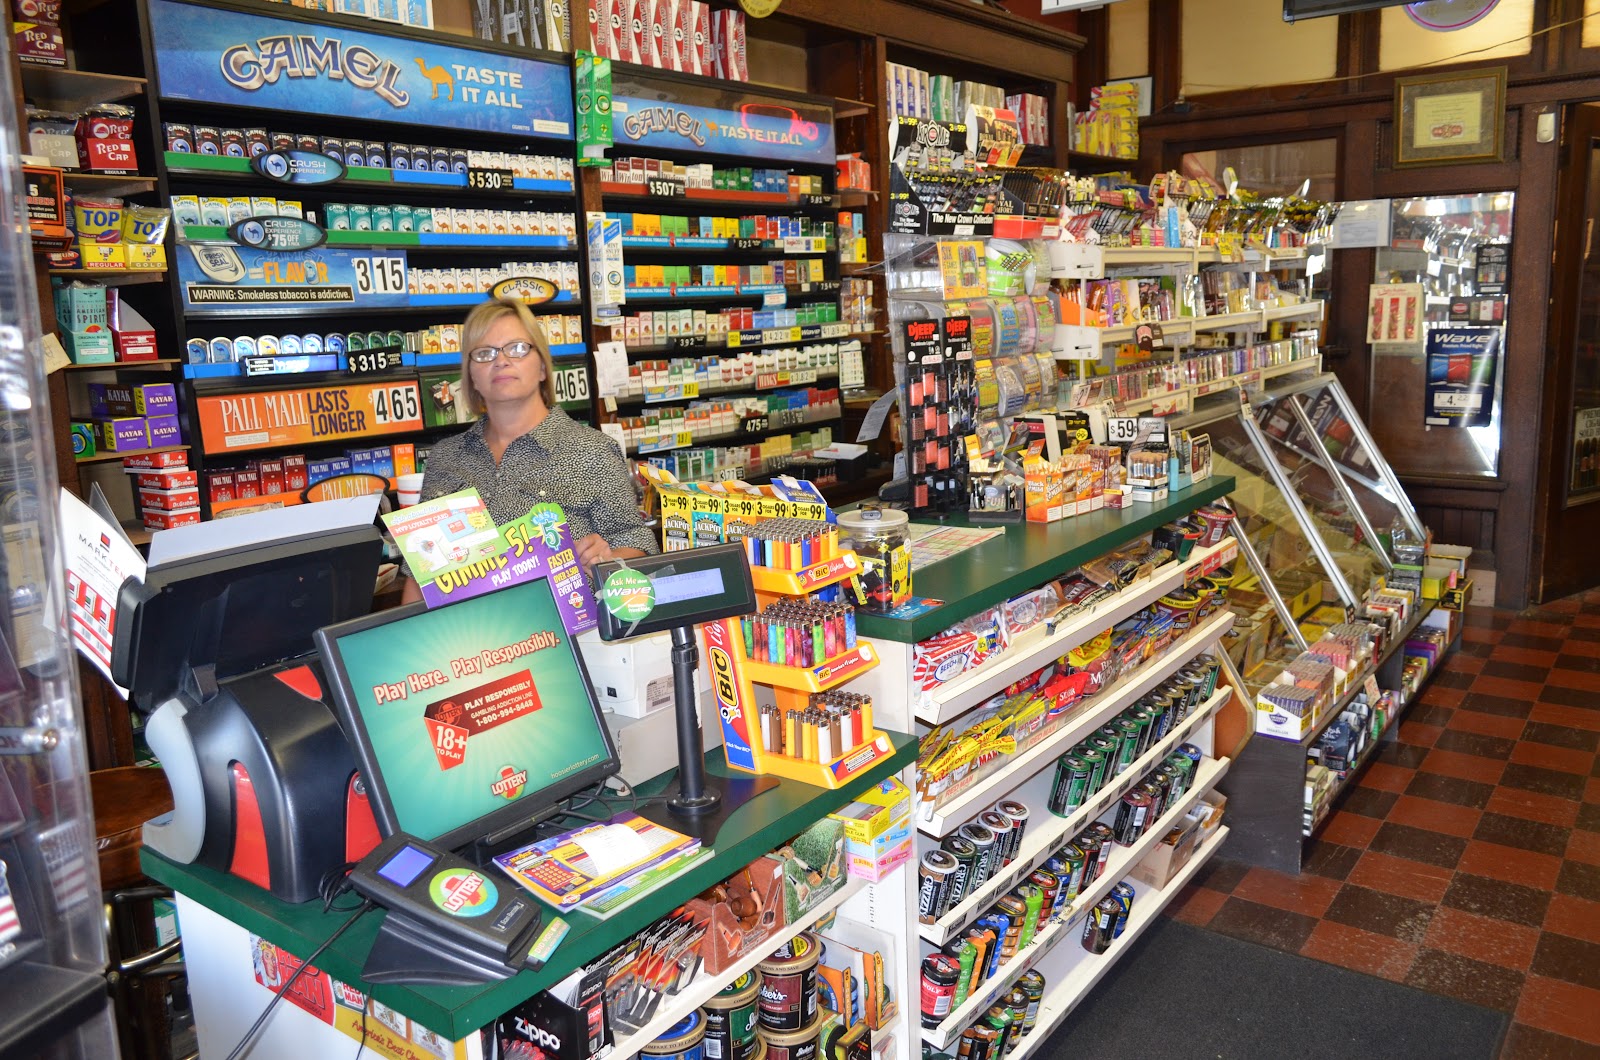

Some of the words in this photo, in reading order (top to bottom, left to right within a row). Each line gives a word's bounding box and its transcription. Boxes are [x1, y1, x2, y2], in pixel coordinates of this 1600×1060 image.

[25, 30, 48, 42] RED
[36, 40, 57, 50] CAP
[220, 35, 410, 109] CAMEL
[451, 63, 524, 89] TASTE
[461, 86, 483, 103] IT
[485, 92, 523, 109] ALL
[109, 124, 129, 134] RED
[622, 106, 706, 147] CAMEL
[719, 124, 764, 142] TASTE
[767, 130, 779, 141] IT
[780, 131, 803, 146] ALL
[96, 143, 120, 155] RED
[108, 152, 129, 161] CAP
[289, 159, 326, 169] CRUSH
[29, 183, 39, 197] 5
[83, 209, 120, 227] TOP
[264, 219, 303, 229] CRUSH
[932, 212, 944, 224] The
[944, 213, 957, 224] New
[957, 214, 974, 224] Crown
[973, 214, 994, 224] Collection
[133, 219, 161, 235] TO
[288, 234, 300, 243] OFF
[204, 251, 225, 262] FRESH
[502, 279, 545, 294] CLASSIC
[192, 289, 237, 300] WARNING:
[237, 289, 278, 300] Smokeless
[279, 289, 310, 301] tobacco
[310, 290, 318, 299] is
[317, 288, 351, 300] addictive.
[76, 307, 106, 315] AMERICAN
[76, 313, 106, 324] SPIRIT
[740, 333, 762, 341] Wave
[1434, 332, 1492, 344] Wave
[107, 388, 131, 402] KAYAK
[306, 389, 350, 415] LASTS
[219, 396, 263, 434] PALL
[264, 391, 309, 430] MALL
[310, 410, 367, 437] LONGER
[118, 429, 144, 439] KAYAK
[153, 426, 178, 436] KAYAK
[321, 480, 345, 500] PALL
[346, 477, 370, 497] MALL
[662, 494, 668, 508] 3
[692, 497, 698, 510] 3
[724, 499, 730, 513] 3
[757, 501, 763, 515] 3
[531, 510, 559, 525] CASH
[791, 504, 798, 518] 3
[395, 525, 408, 534] MVP
[407, 517, 434, 530] LOYALTY
[433, 512, 449, 522] CARD
[664, 518, 690, 532] JACKPOT
[693, 521, 722, 535] JACKPOT
[448, 548, 470, 560] LOTTERY
[547, 548, 575, 570] FASTER
[491, 571, 511, 587] PLAY
[512, 555, 541, 580] TODAY!
[553, 571, 567, 584] OVER
[610, 577, 624, 586] Ask
[625, 577, 637, 585] Me
[557, 583, 574, 598] EVERY
[606, 586, 652, 598] Wave
[1140, 611, 1149, 619] 12
[373, 681, 409, 706] Play
[407, 669, 450, 695] Here.
[450, 655, 483, 679] Play
[481, 630, 562, 669] Responsibly.
[464, 697, 484, 711] PLAY
[484, 680, 532, 703] RESPONSIBLY
[470, 704, 497, 719] GAMBLING
[496, 696, 522, 712] ADDICTION
[521, 691, 534, 702] LINE
[434, 704, 463, 723] LOTTERY
[475, 699, 534, 727] 1-800-994-8448
[435, 725, 467, 751] 18+
[436, 748, 446, 756] TO
[445, 750, 462, 760] PLAY
[978, 750, 999, 766] MAN
[550, 753, 600, 780] hoosierlottery.com
[490, 770, 528, 796] LOTTERY
[951, 863, 967, 905] GRIZZLY
[441, 872, 485, 913] LOTTERY
[920, 875, 934, 920] GRIZZLY
[344, 990, 364, 1007] MAN
[351, 1019, 386, 1046] America's
[386, 1036, 405, 1057] Best
